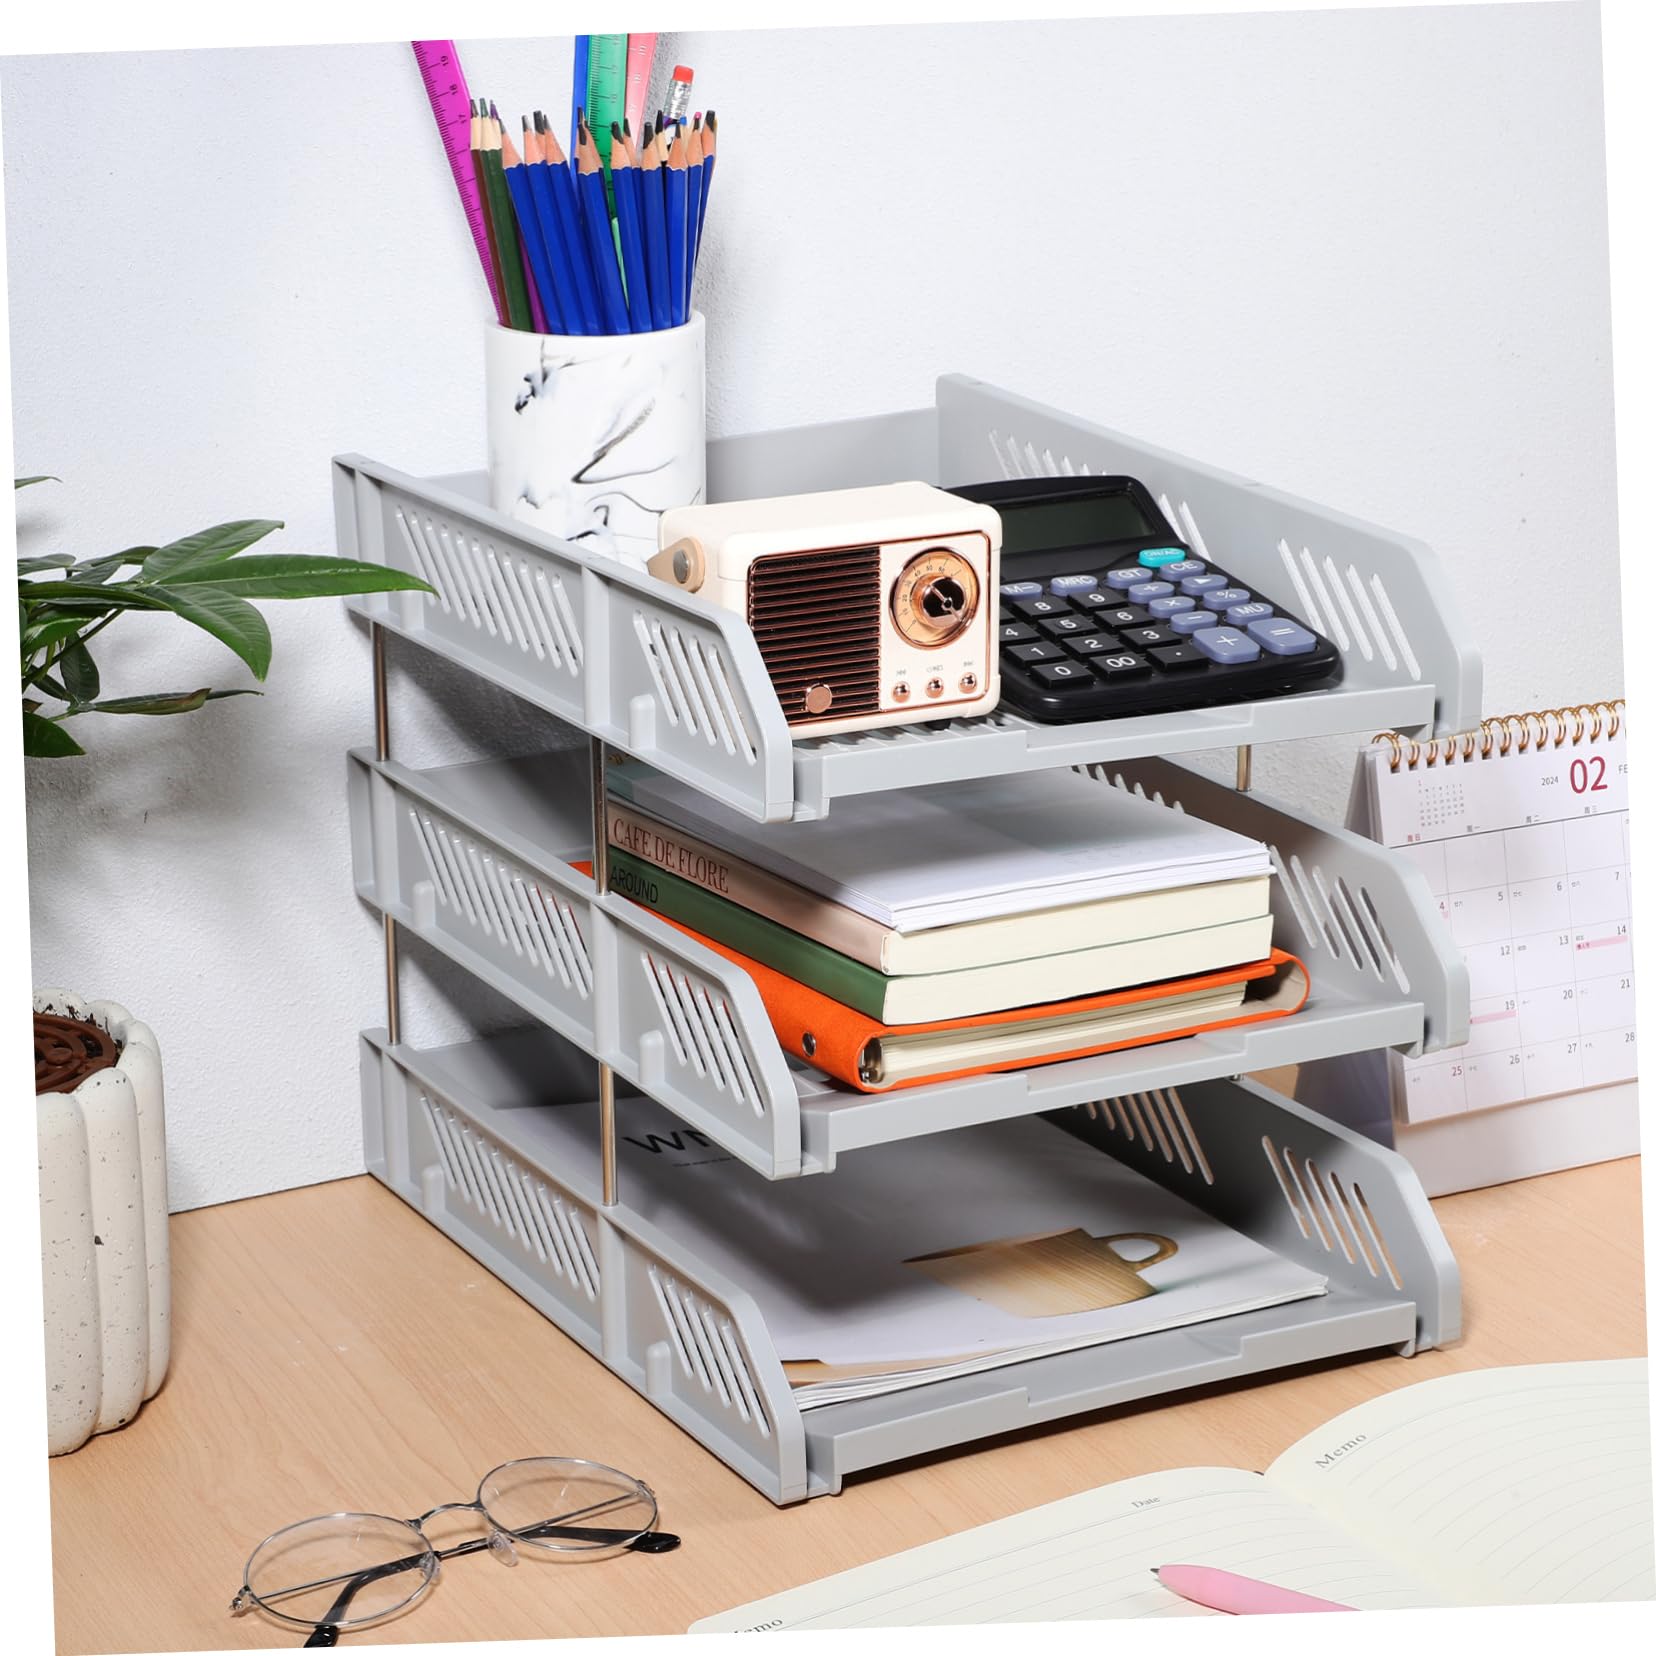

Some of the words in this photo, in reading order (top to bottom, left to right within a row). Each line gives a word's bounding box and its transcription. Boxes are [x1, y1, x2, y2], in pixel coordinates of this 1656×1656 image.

[1170, 560, 1198, 572] CE
[1118, 569, 1143, 579] GT
[1056, 576, 1093, 586] MRC
[1088, 593, 1106, 603] 9
[1034, 601, 1052, 611] 8
[1236, 605, 1264, 615] MU
[1116, 611, 1134, 621] 6
[1060, 619, 1077, 629] 5
[1005, 628, 1019, 637] 4
[1142, 630, 1161, 640] 3
[1084, 639, 1103, 649] 2
[1030, 647, 1045, 656] 1
[1106, 656, 1136, 669] 00
[1054, 665, 1072, 676] 0
[1541, 776, 1559, 786] 2024
[1569, 756, 1608, 794] 02
[613, 817, 652, 858] CAFE
[655, 835, 675, 869] DE
[678, 845, 729, 894] FLORE
[611, 864, 659, 904] AROUND
[1556, 881, 1563, 891] 6
[1497, 891, 1504, 902] 5
[1439, 901, 1446, 910] 4
[1616, 925, 1627, 936] 14
[1559, 935, 1569, 946] 13
[1500, 945, 1511, 956] 12
[1620, 978, 1631, 989] 21
[1563, 989, 1573, 1000] 20
[1505, 1000, 1515, 1011] 19
[1625, 1032, 1635, 1043] 28
[1567, 1043, 1577, 1054] 27
[1509, 1054, 1521, 1065] 26
[1451, 1066, 1463, 1077] 25
[1315, 1432, 1367, 1469] Memo
[1131, 1495, 1161, 1509] Date
